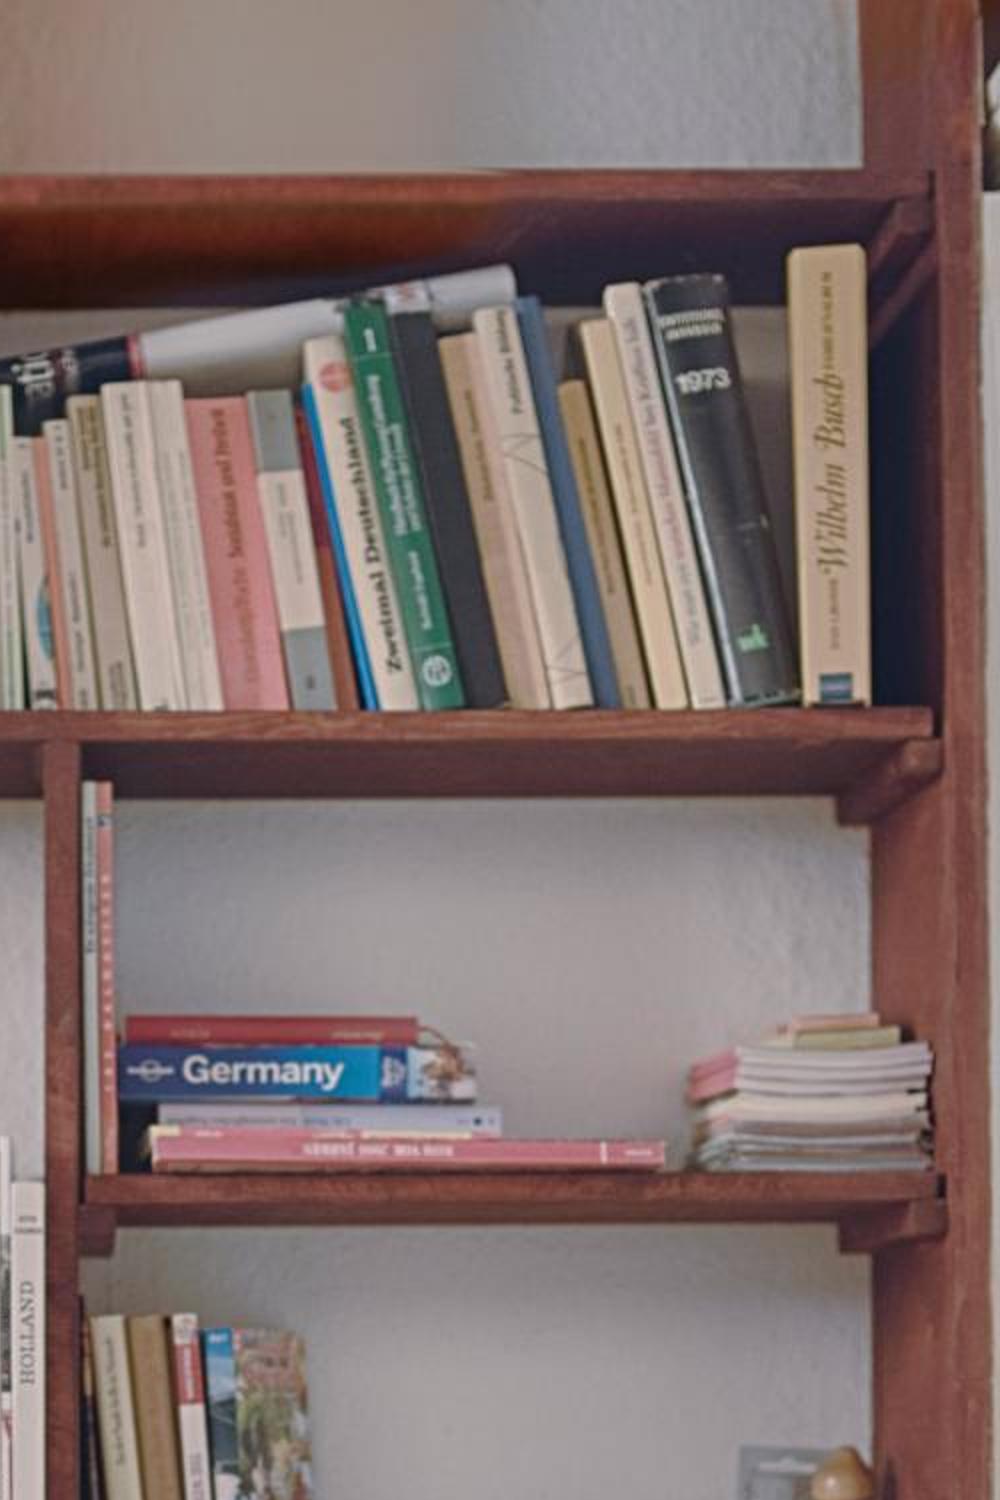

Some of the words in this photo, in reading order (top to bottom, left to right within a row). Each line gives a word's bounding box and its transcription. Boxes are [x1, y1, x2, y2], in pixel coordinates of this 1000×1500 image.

[810, 373, 847, 449] Busch
[338, 416, 384, 566] Deutschland
[812, 462, 849, 577] Wilhelm
[368, 571, 404, 674] Zweimal
[181, 1053, 345, 1090] Germany
[19, 1280, 36, 1386] HOLLAND
